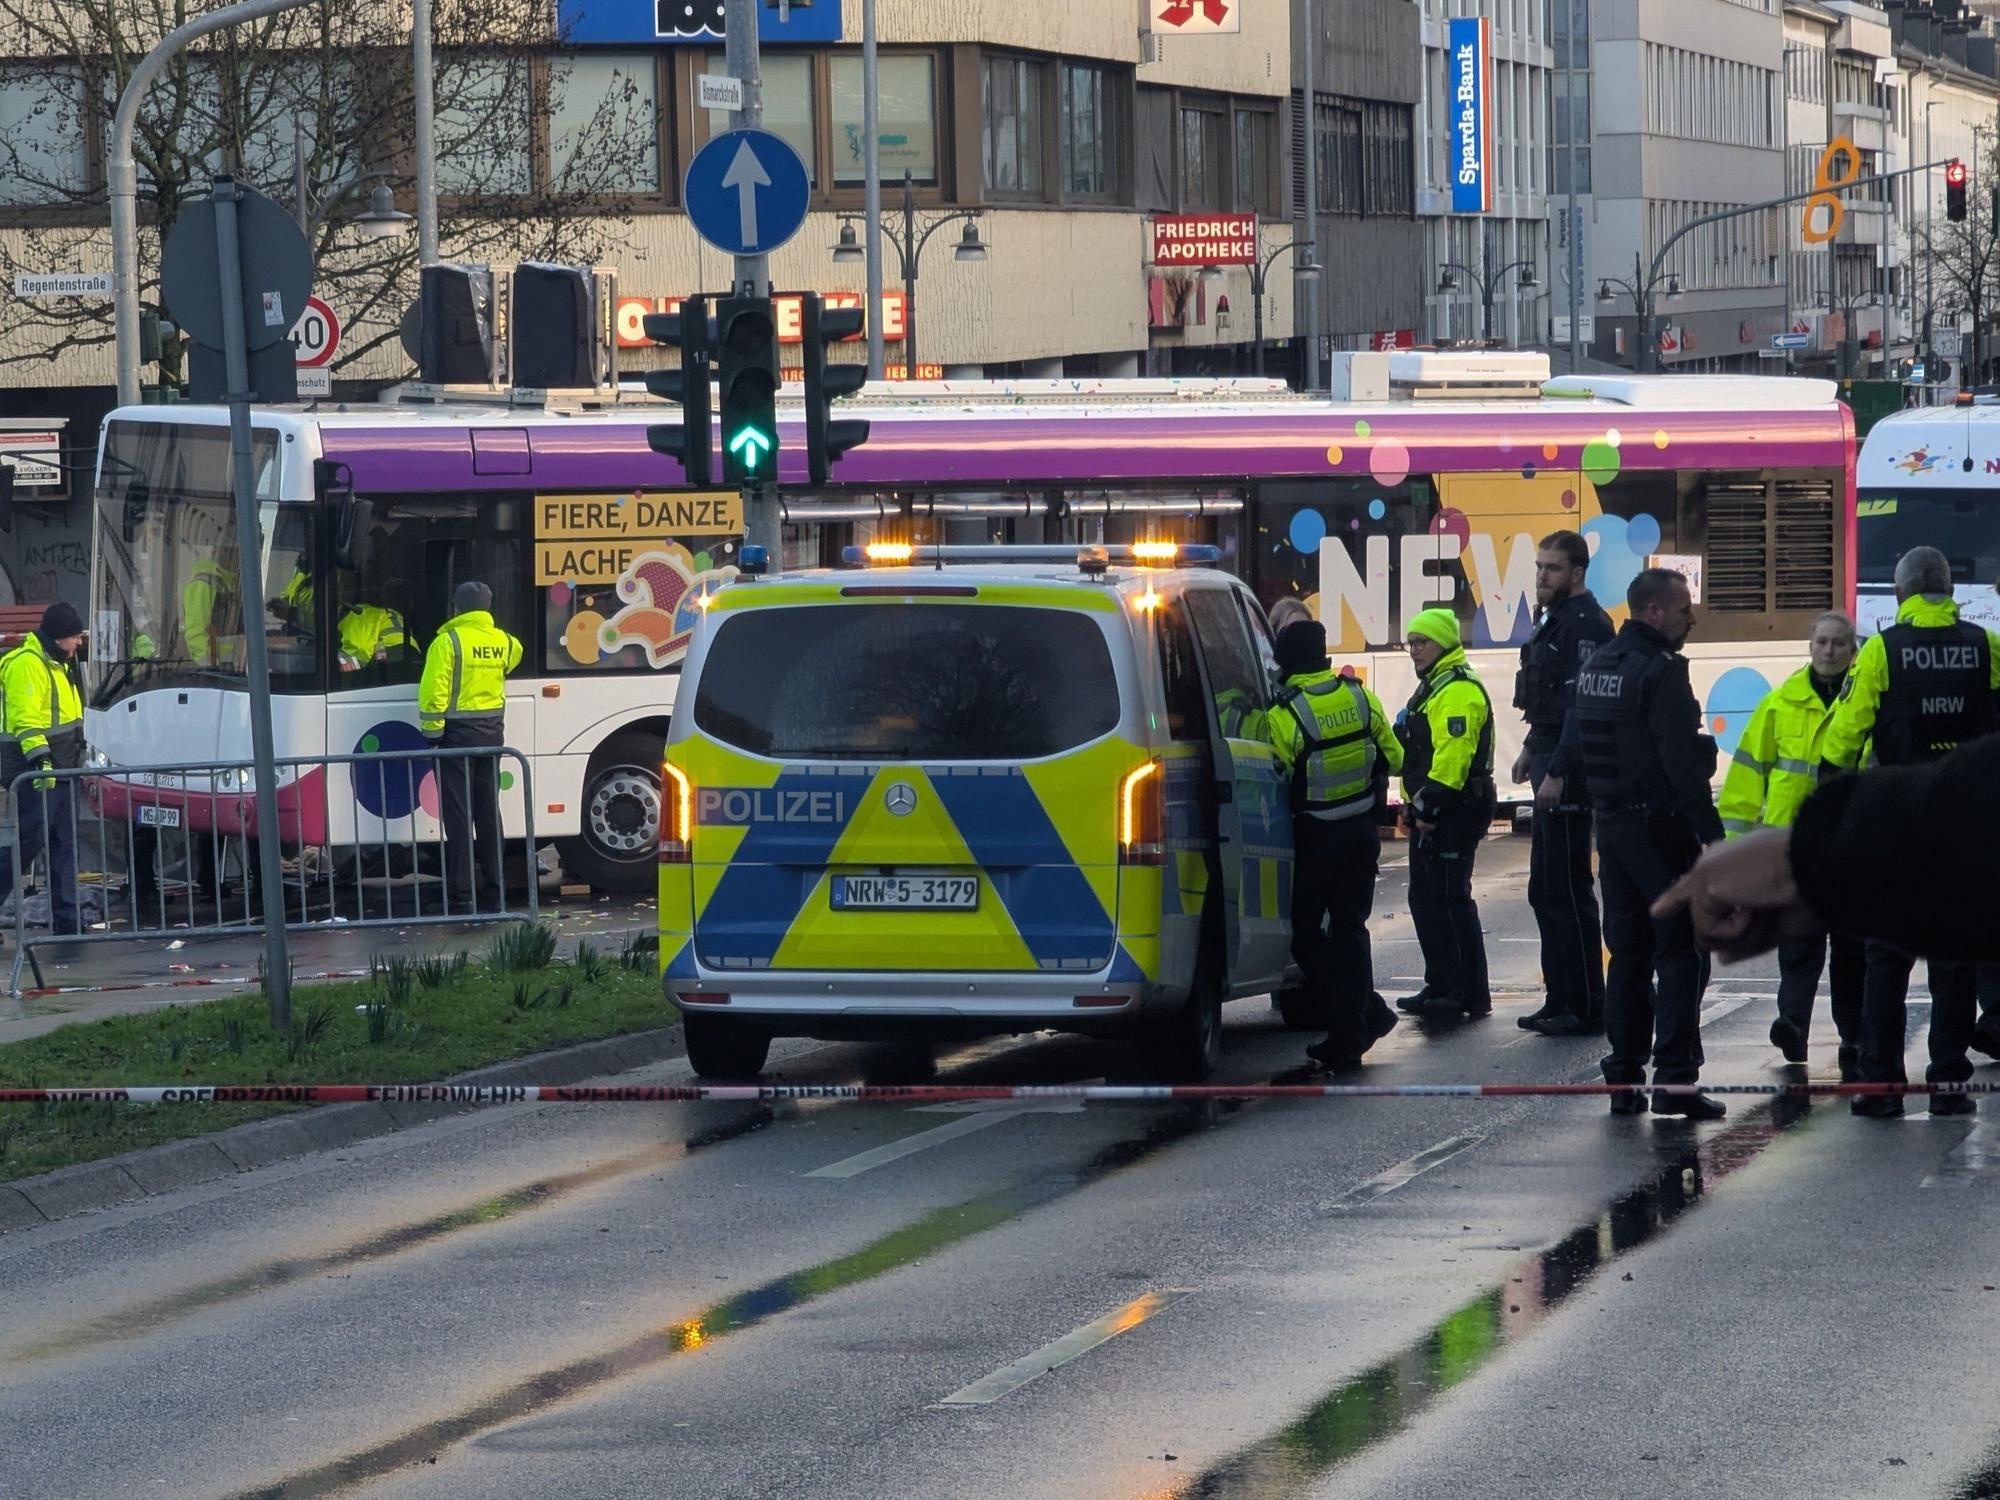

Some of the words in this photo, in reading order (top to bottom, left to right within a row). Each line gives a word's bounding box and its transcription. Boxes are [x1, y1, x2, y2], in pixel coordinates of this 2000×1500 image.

[702, 80, 739, 104] Bismarckstraße
[1457, 44, 1479, 184] Sparda-Bank
[1156, 221, 1254, 239] FRIEDRICH
[1158, 242, 1254, 259] APOTHEKE
[21, 276, 107, 294] Regentenstraße
[544, 502, 628, 533] FIERE,
[637, 500, 735, 530] DANZE,
[545, 549, 633, 576] LACHE
[1319, 533, 1543, 646] NEW
[472, 646, 504, 659] NEW
[1902, 646, 1979, 670] POLIZEI
[1577, 672, 1623, 698] POLIZEI
[1316, 704, 1361, 730] POLIZEI
[1922, 697, 1965, 715] NRW
[699, 790, 844, 822] POLIZEI
[845, 880, 885, 902] NRW
[898, 880, 975, 903] 5-3179
[367, 1086, 527, 1102] FEUERWEHR
